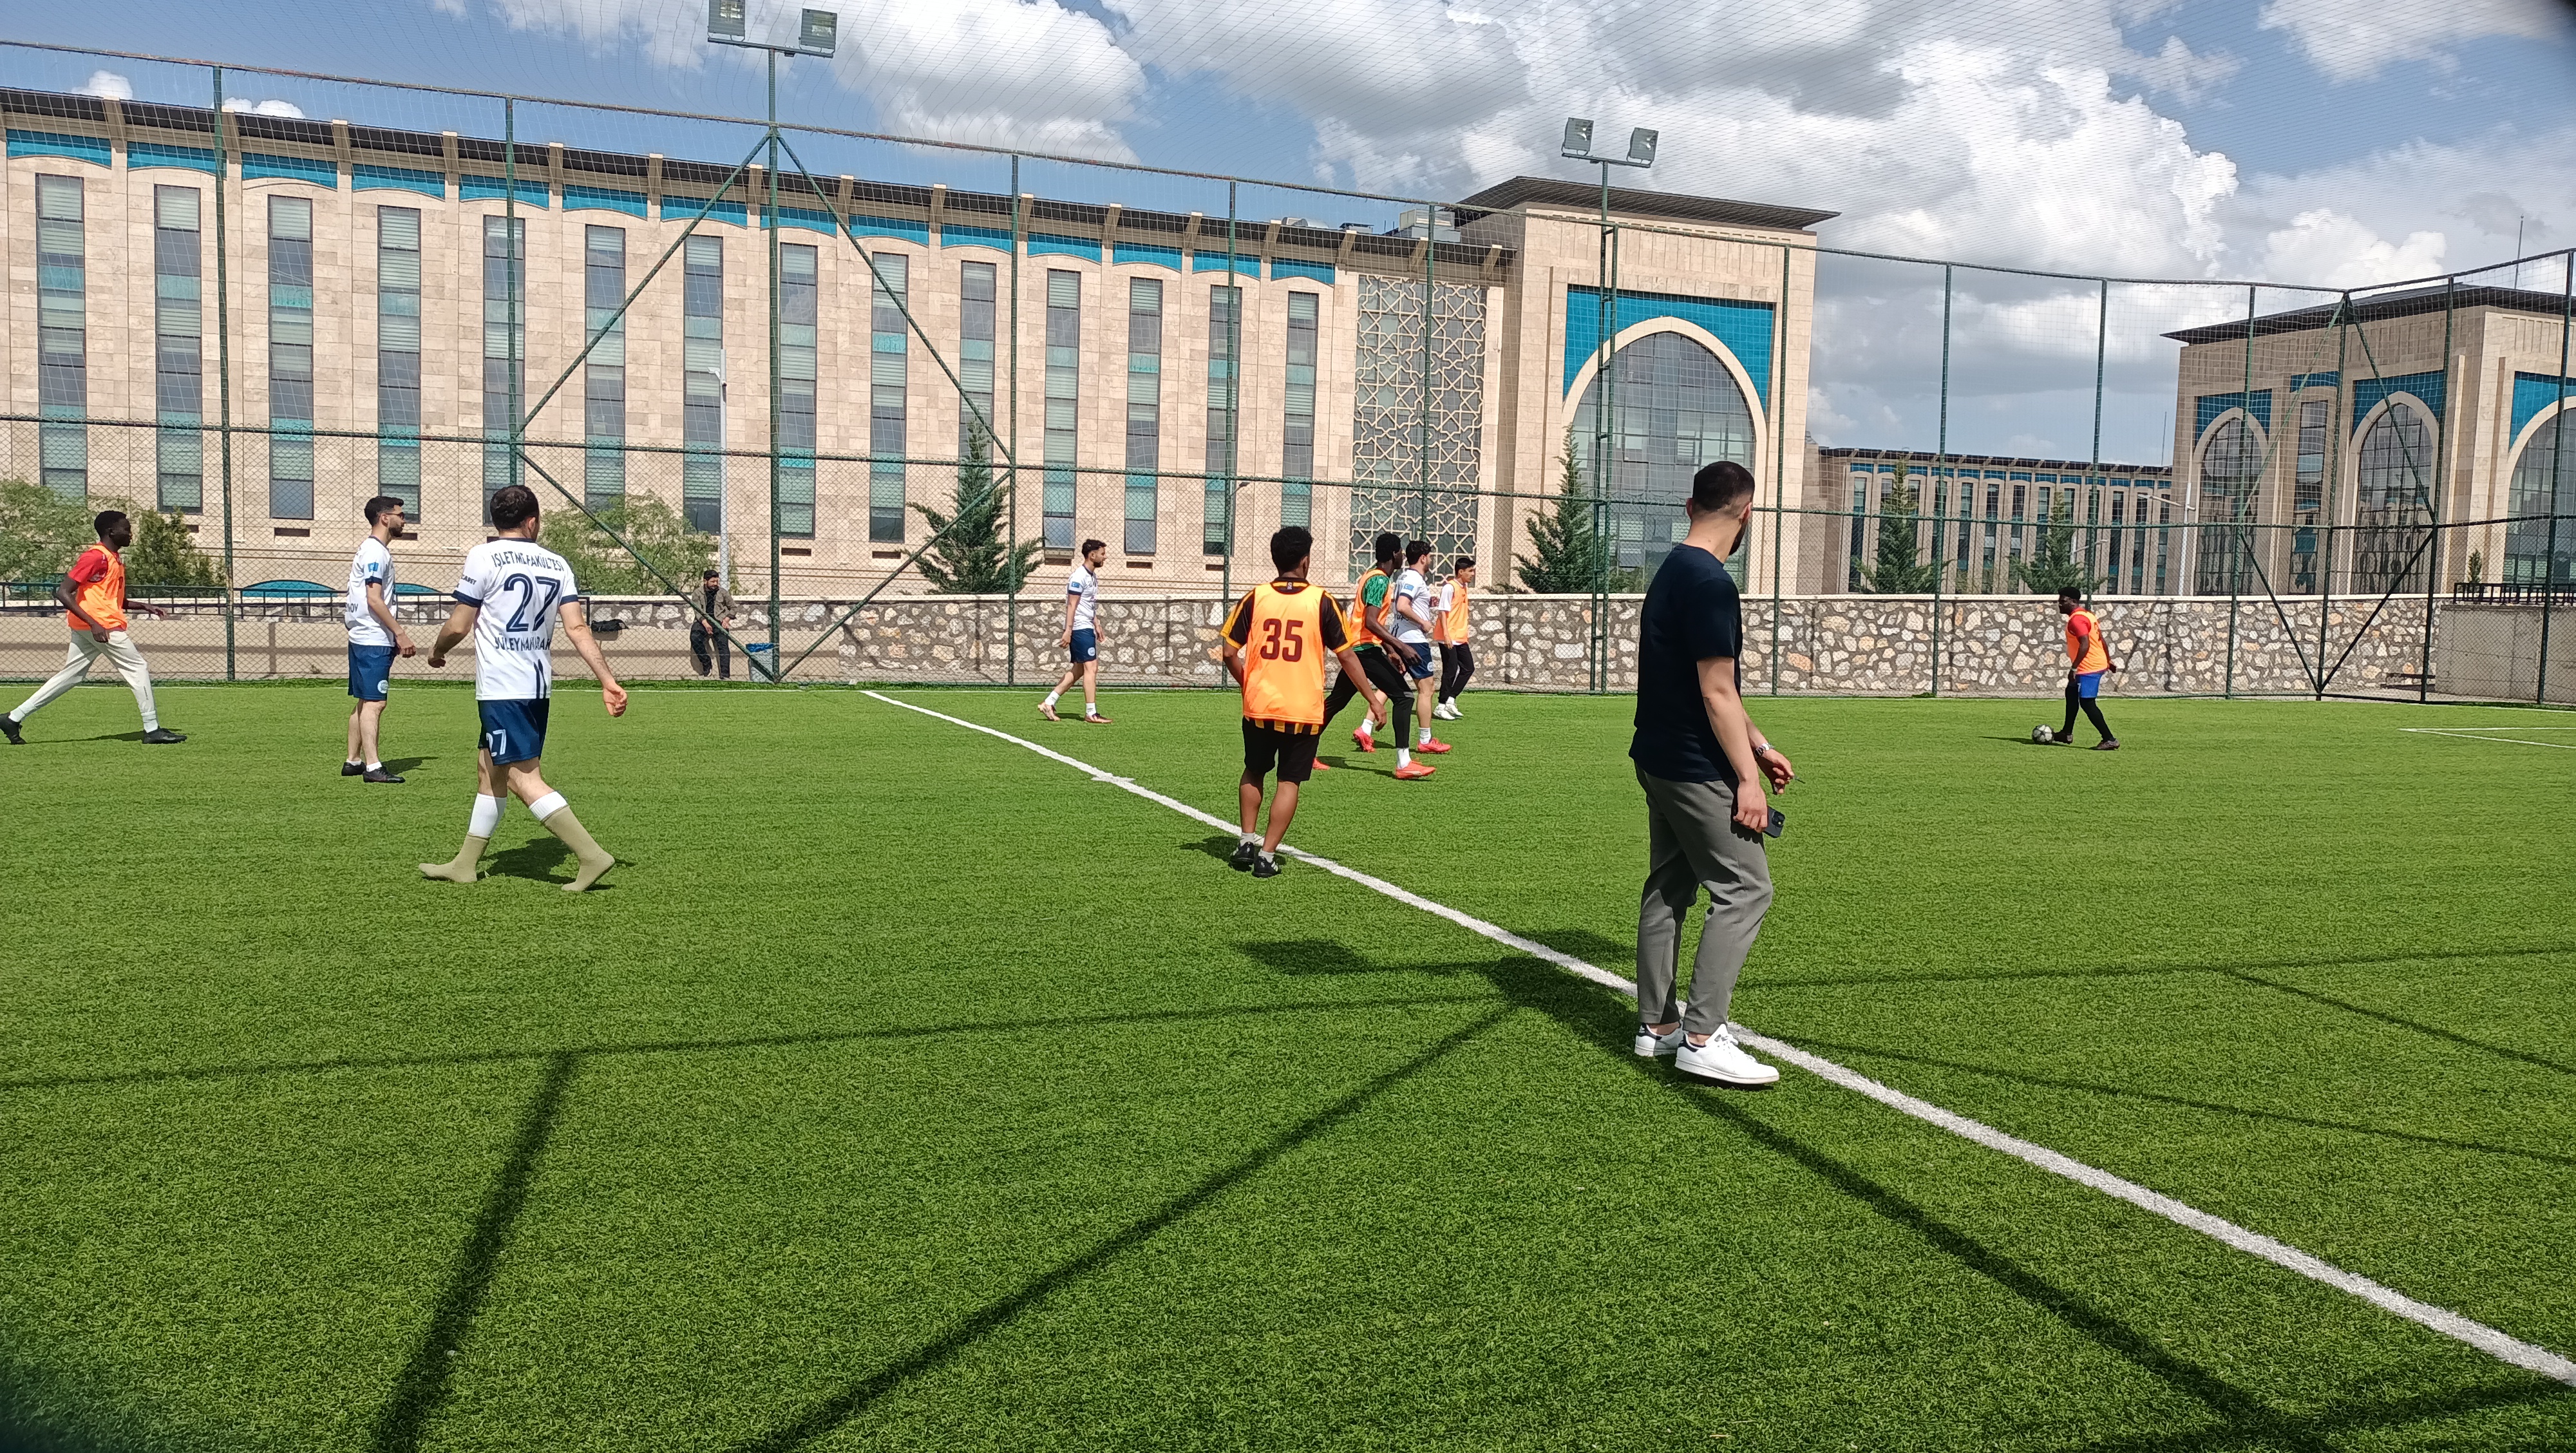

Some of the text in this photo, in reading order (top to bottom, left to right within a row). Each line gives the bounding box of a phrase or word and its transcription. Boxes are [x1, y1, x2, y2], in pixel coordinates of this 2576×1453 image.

[504, 573, 561, 632] 27
[1260, 618, 1303, 662] 35
[486, 728, 507, 757] 27
